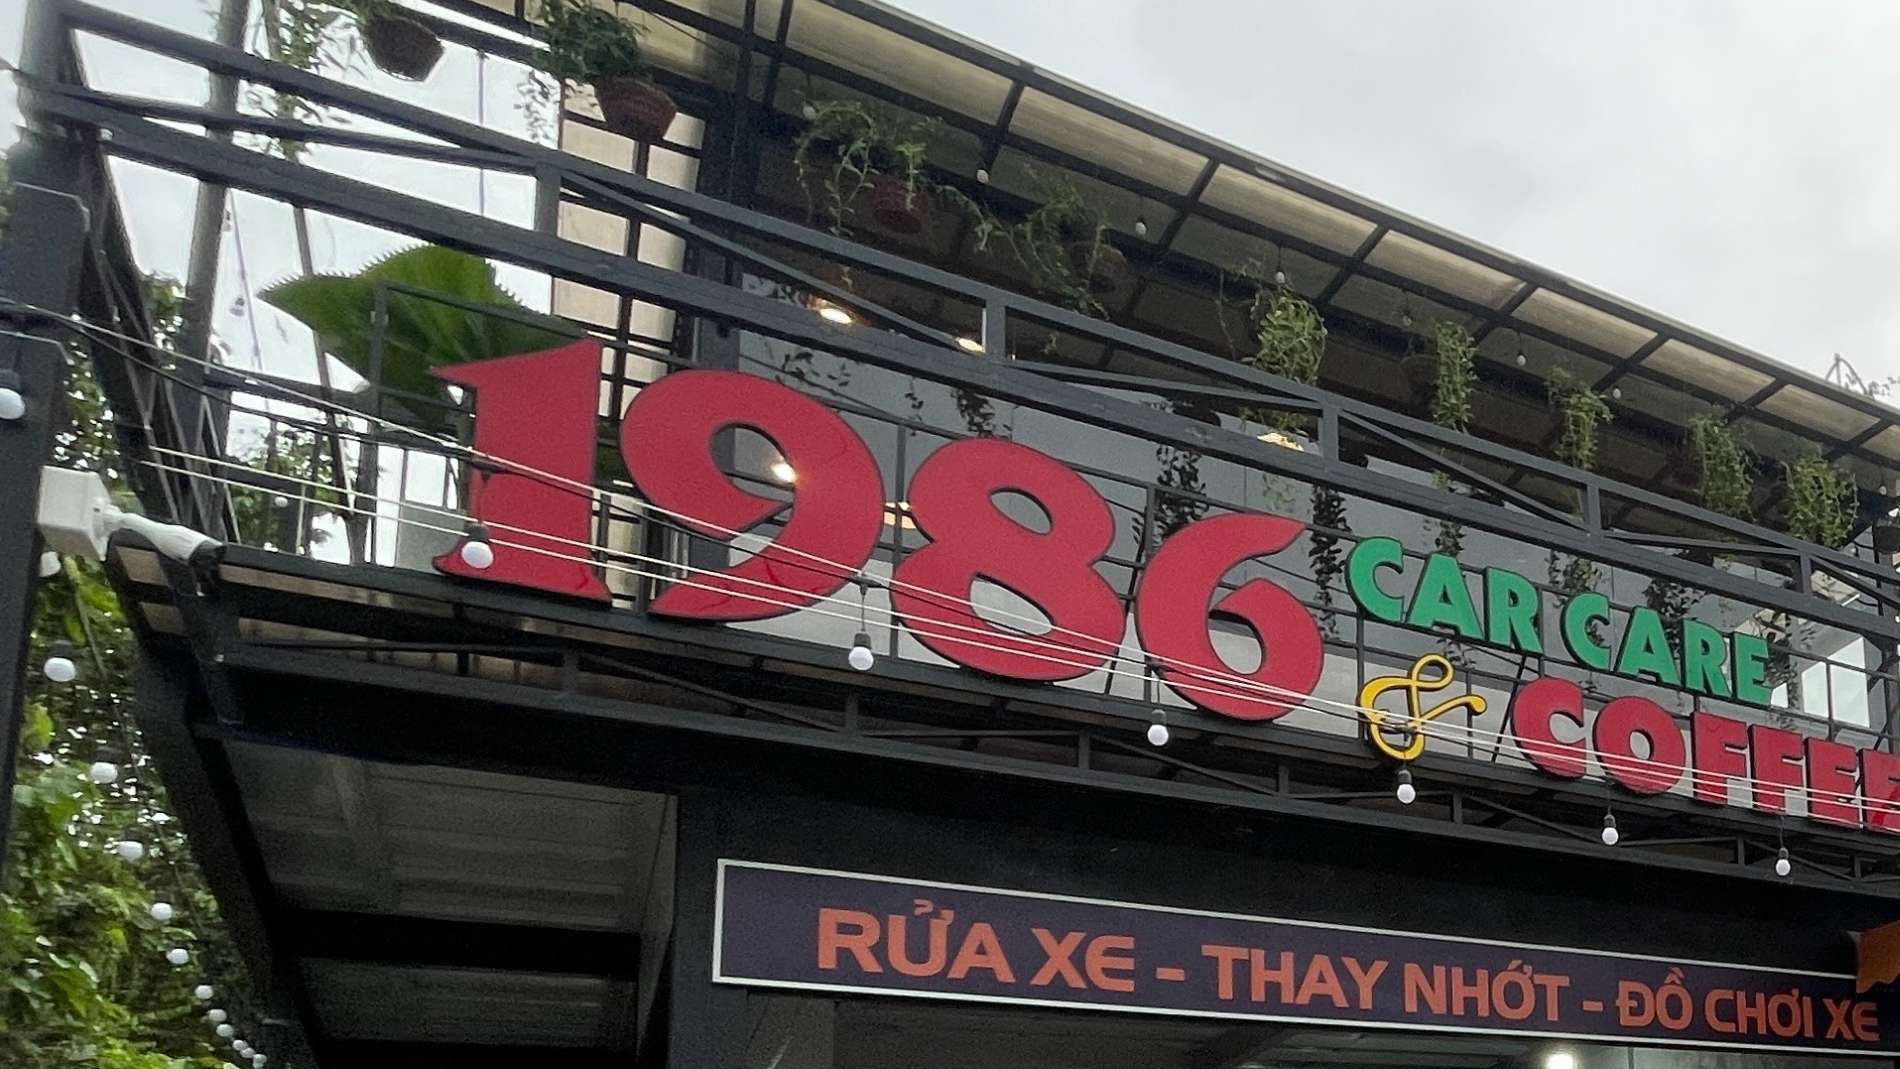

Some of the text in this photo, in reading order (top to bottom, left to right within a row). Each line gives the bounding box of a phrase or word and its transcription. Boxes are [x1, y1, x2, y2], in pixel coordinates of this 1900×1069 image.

[430, 338, 1324, 721] 1986
[1346, 536, 1774, 708] CAR CARE
[1359, 653, 1487, 762] &
[817, 899, 1016, 984] RỬA
[1029, 928, 1136, 993] XE
[1201, 944, 1389, 1010] THAY
[1404, 959, 1570, 1022] NHỚT
[1615, 966, 1693, 1030] ĐỒ
[1705, 988, 1814, 1038] CHƠI
[1824, 998, 1880, 1041] XE
